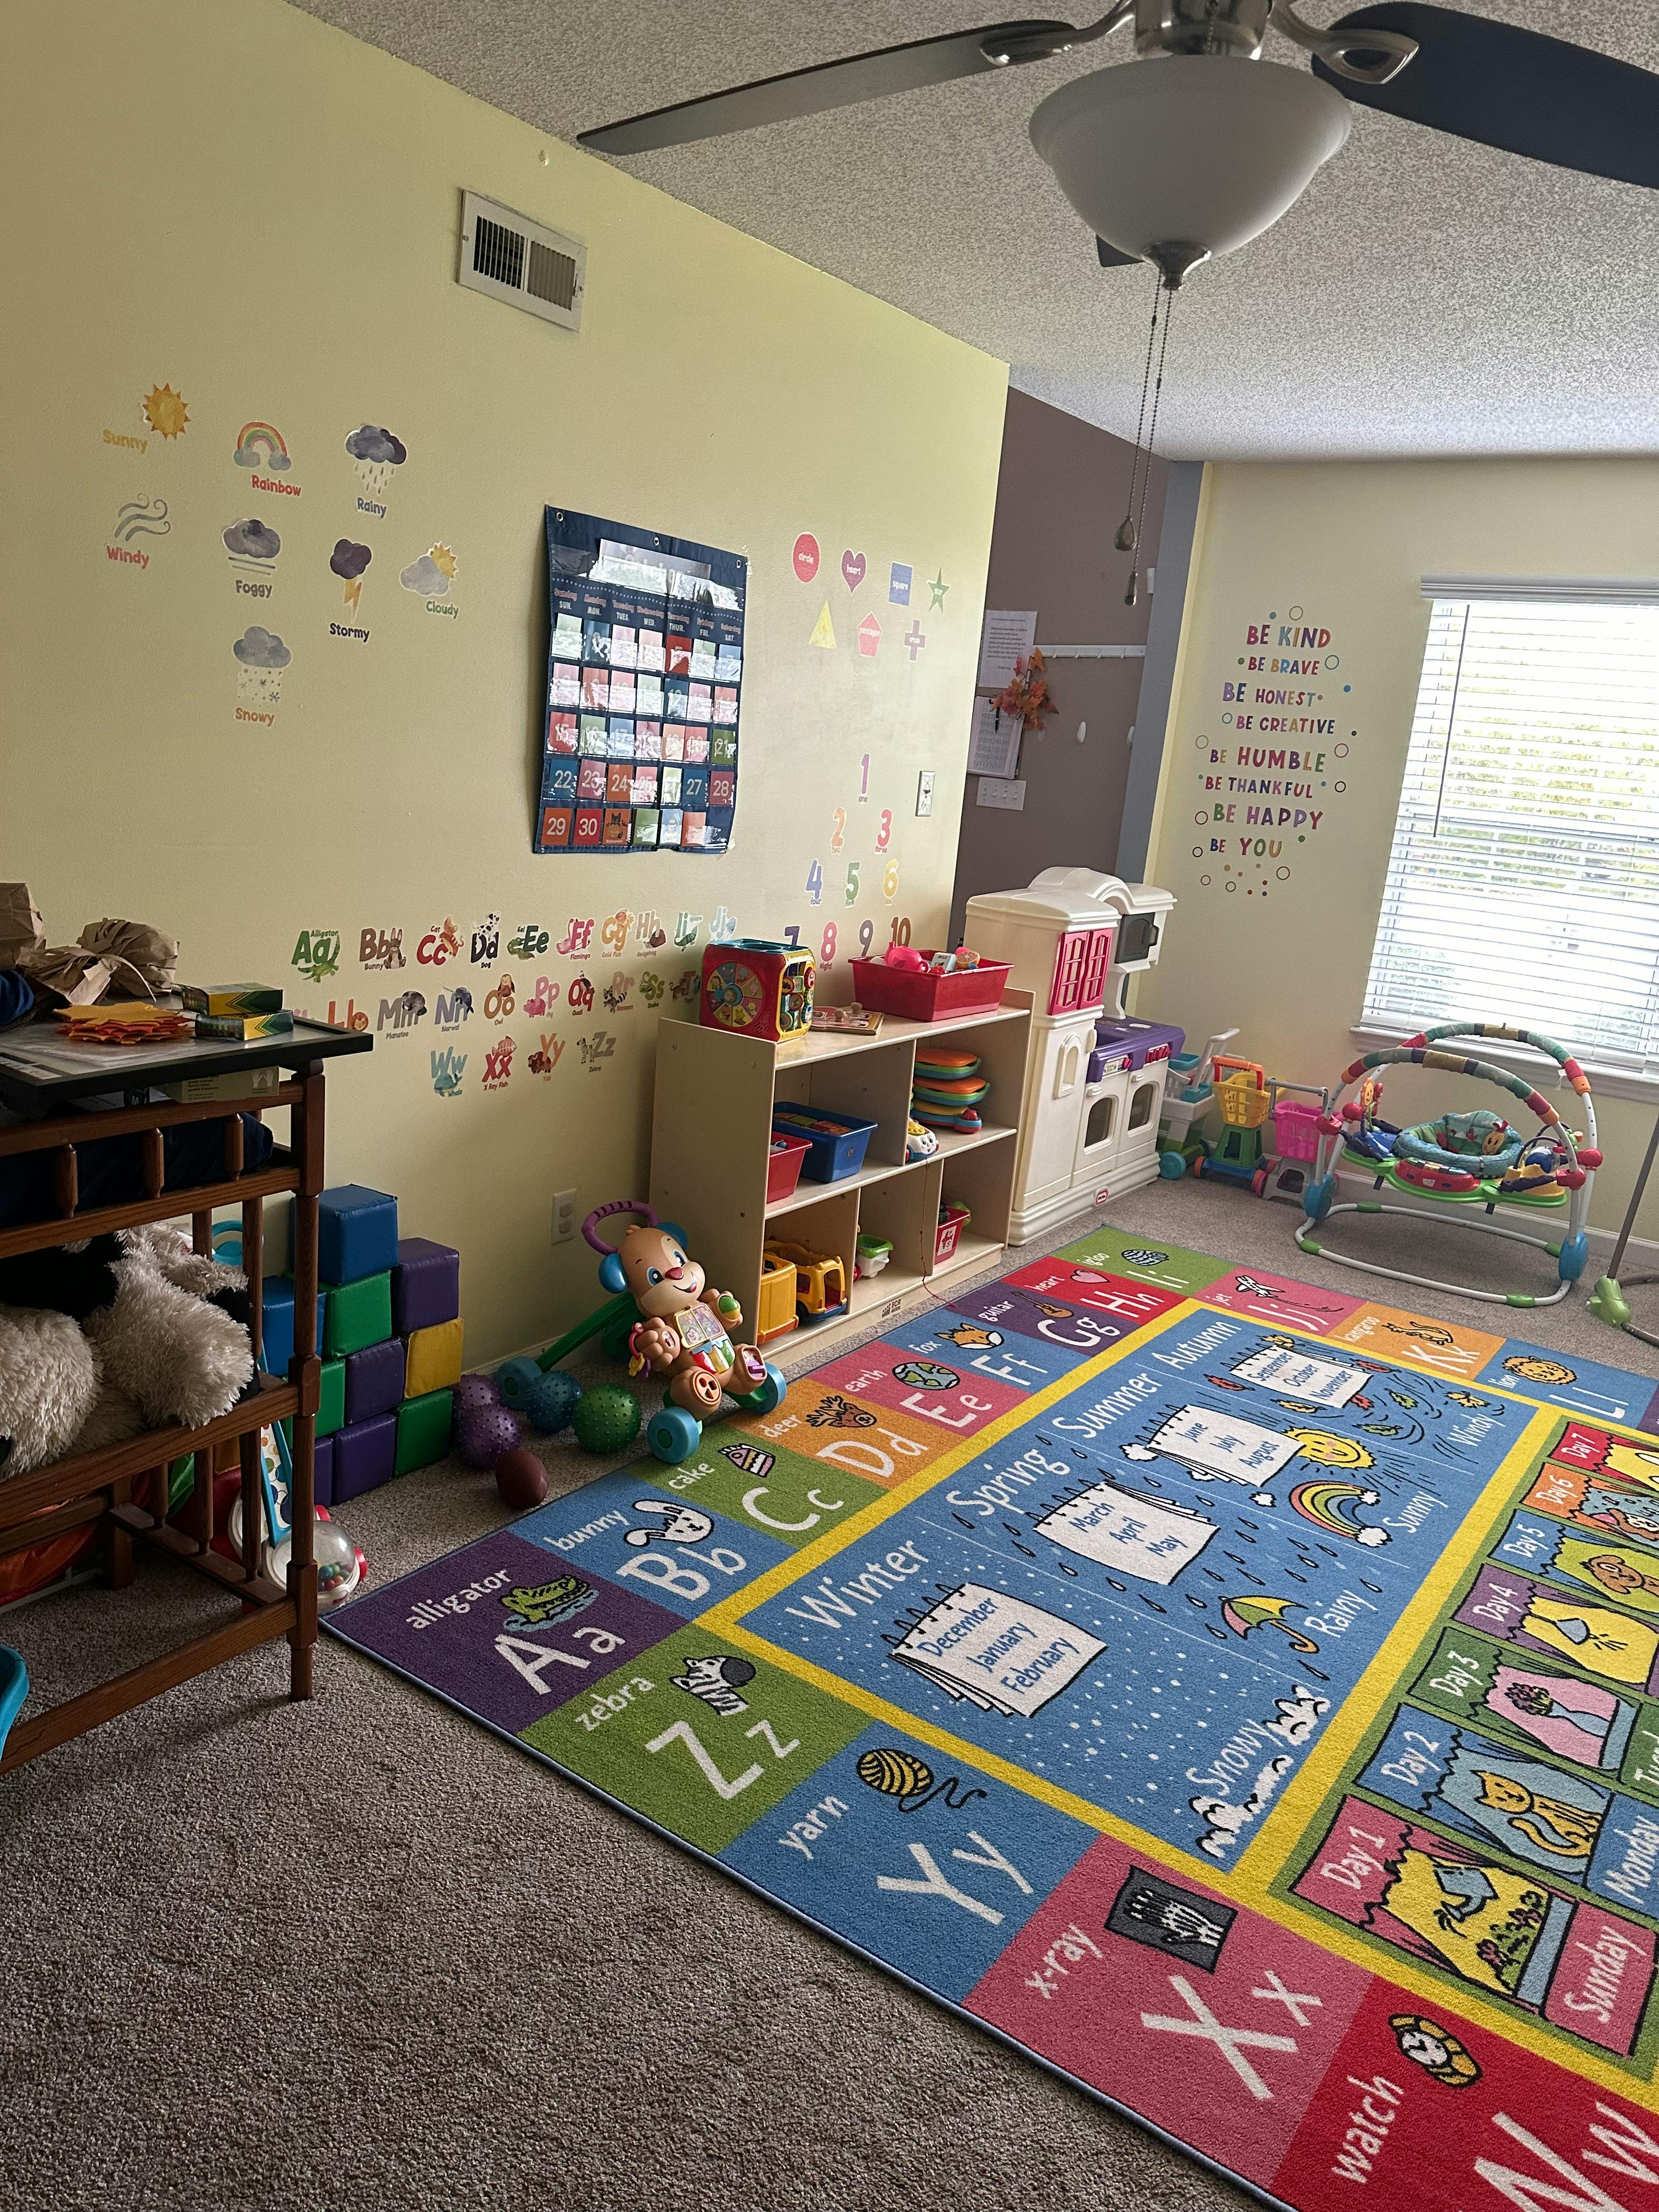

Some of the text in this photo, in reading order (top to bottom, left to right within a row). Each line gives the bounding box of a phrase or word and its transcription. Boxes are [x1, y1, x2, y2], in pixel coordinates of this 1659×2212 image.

[102, 429, 148, 454] Sunny
[252, 475, 301, 496] Rainbow
[357, 497, 387, 518] Rainy
[107, 546, 150, 568] Windy
[235, 580, 273, 599] Foggy
[426, 600, 459, 619] Cloudy
[329, 623, 370, 642] Stormy
[1246, 624, 1331, 648] BE KIND
[1248, 657, 1320, 675] BE BRAVE
[1222, 682, 1316, 707] BE HONEST
[235, 708, 274, 726] Snowy
[1236, 715, 1335, 734] BE CREATIVE
[861, 754, 870, 794] 1
[1210, 746, 1326, 772] BE HUMBLE
[554, 770, 729, 797] 22 23 24 27 28
[1205, 776, 1312, 798] BE THANKFUL
[546, 817, 598, 836] 29 30
[831, 808, 845, 847] 2
[877, 809, 891, 847] 3
[1214, 803, 1323, 830] BE HAPPY
[1210, 837, 1282, 858] BE YOU
[806, 860, 822, 899] 4
[845, 862, 860, 900] 5
[883, 859, 899, 896] 6
[311, 929, 338, 938] Alligator
[523, 925, 549, 953] Ee
[571, 919, 595, 950] Ff
[602, 916, 628, 951] Gg
[636, 911, 661, 940] Hh
[860, 920, 873, 956] 9
[891, 917, 911, 947] 10
[291, 930, 330, 965] Aa
[359, 928, 391, 962] Bb
[416, 934, 448, 966] Cc
[471, 932, 499, 963] Dd
[821, 922, 837, 961] 8
[484, 990, 515, 1019] Oo
[535, 976, 560, 1009] Pp
[377, 998, 419, 1031] Mm
[435, 994, 467, 1024] Nn
[386, 1031, 409, 1040] Manatee
[540, 1033, 566, 1069] Yy
[592, 1031, 616, 1058] Zz
[431, 1046, 468, 1079] Ww
[482, 1053, 512, 1082] Xx
[1076, 1252, 1110, 1266] igloo
[1024, 1276, 1065, 1292] heart
[1125, 1270, 1189, 1289] Ii
[979, 1300, 1014, 1322] guitar
[1080, 1290, 1165, 1319] Hh
[1205, 1293, 1233, 1307] jet
[1037, 1317, 1120, 1347] Gg
[1247, 1304, 1329, 1331] Jj
[1334, 1316, 1381, 1343] kangaroo
[909, 1340, 942, 1354] fox
[1152, 1321, 1242, 1370] Autumn
[1402, 1342, 1481, 1374] Kk
[844, 1369, 888, 1393] earth
[970, 1353, 1048, 1386] Ff
[1247, 1351, 1295, 1382] September
[1283, 1363, 1320, 1387] October
[1487, 1374, 1519, 1390] lion
[1308, 1370, 1353, 1401] November
[900, 1391, 992, 1428] Ee
[1052, 1373, 1163, 1439] Summer
[1548, 1387, 1629, 1419] Ll
[764, 1414, 804, 1439] deer
[1176, 1421, 1208, 1440] June
[1447, 1413, 1506, 1447] Windy
[816, 1427, 930, 1477] Dd
[1210, 1434, 1246, 1452] July
[1239, 1440, 1280, 1469] August
[1561, 1432, 1600, 1459] Day 7
[668, 1461, 716, 1491] cake
[945, 1448, 1071, 1517] Spring
[1536, 1475, 1578, 1505] Day 6
[742, 1486, 845, 1531] Cc
[1068, 1502, 1116, 1532] March
[1383, 1491, 1449, 1533] Sunny
[543, 1509, 631, 1551] bunny
[1109, 1517, 1147, 1544] April
[1503, 1523, 1549, 1558] Day 5
[1146, 1534, 1189, 1559] May
[616, 1546, 747, 1601] Bb
[785, 1539, 929, 1629] Winter
[405, 1568, 514, 1629] alligator
[1304, 1589, 1379, 1639] Rainy
[1470, 1583, 1522, 1623] Day 4
[917, 1596, 1000, 1657] December
[494, 1627, 627, 1695] Aa
[966, 1621, 1036, 1673] January
[1001, 1637, 1081, 1695] February
[1429, 1650, 1483, 1698] Day 3
[574, 1677, 654, 1733] zebra
[645, 1720, 802, 1800] Zz
[1185, 1718, 1285, 1797] Snowy
[1380, 1730, 1442, 1787] Day 2
[778, 1793, 850, 1860] yarn
[1319, 1826, 1386, 1889] Day 1
[1603, 1815, 1659, 1904] Monday
[877, 1830, 1034, 1926] Yy
[1024, 1922, 1103, 1999] x-ray
[1564, 1926, 1648, 2023] Sunday
[1140, 1970, 1323, 2100] Xx
[1331, 2074, 1405, 2184] watch
